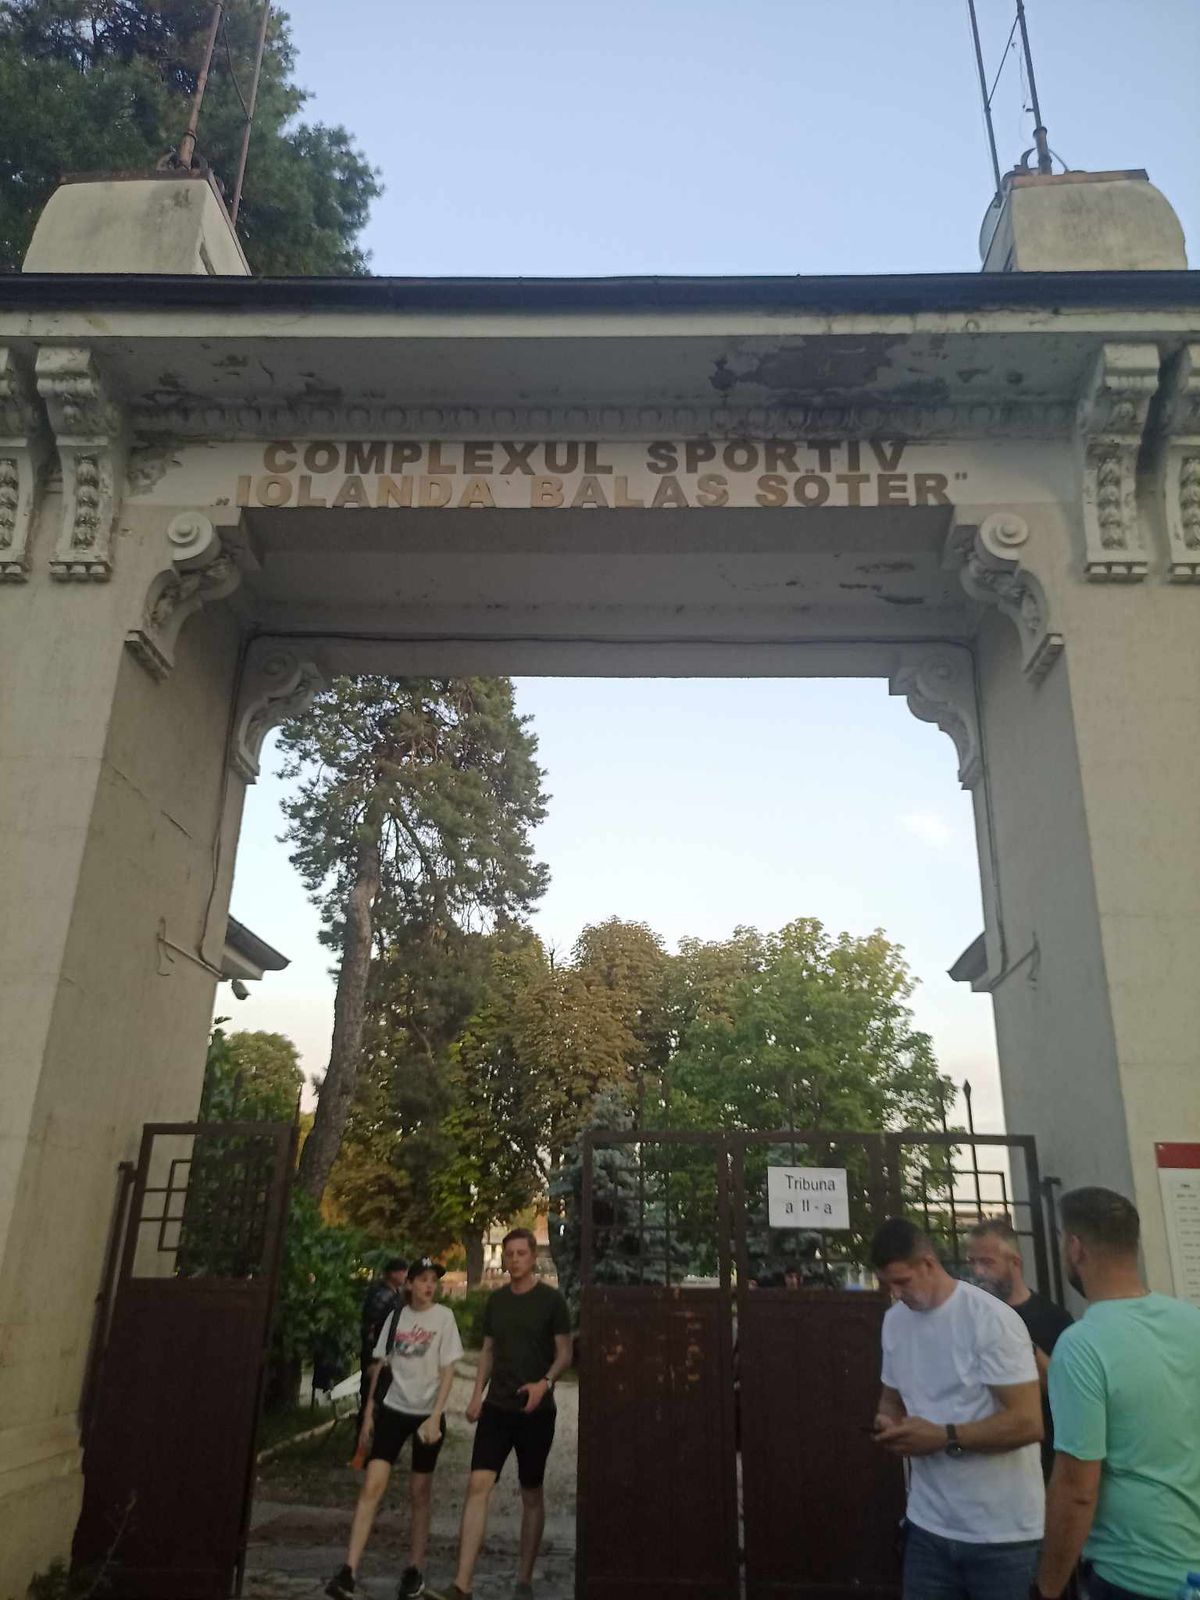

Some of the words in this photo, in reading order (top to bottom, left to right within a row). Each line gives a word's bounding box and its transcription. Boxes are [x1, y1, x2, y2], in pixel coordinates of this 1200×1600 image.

[263, 440, 613, 475] COMPLEXUL
[646, 438, 908, 474] SPORTIV
[784, 1174, 836, 1191] Tribuna
